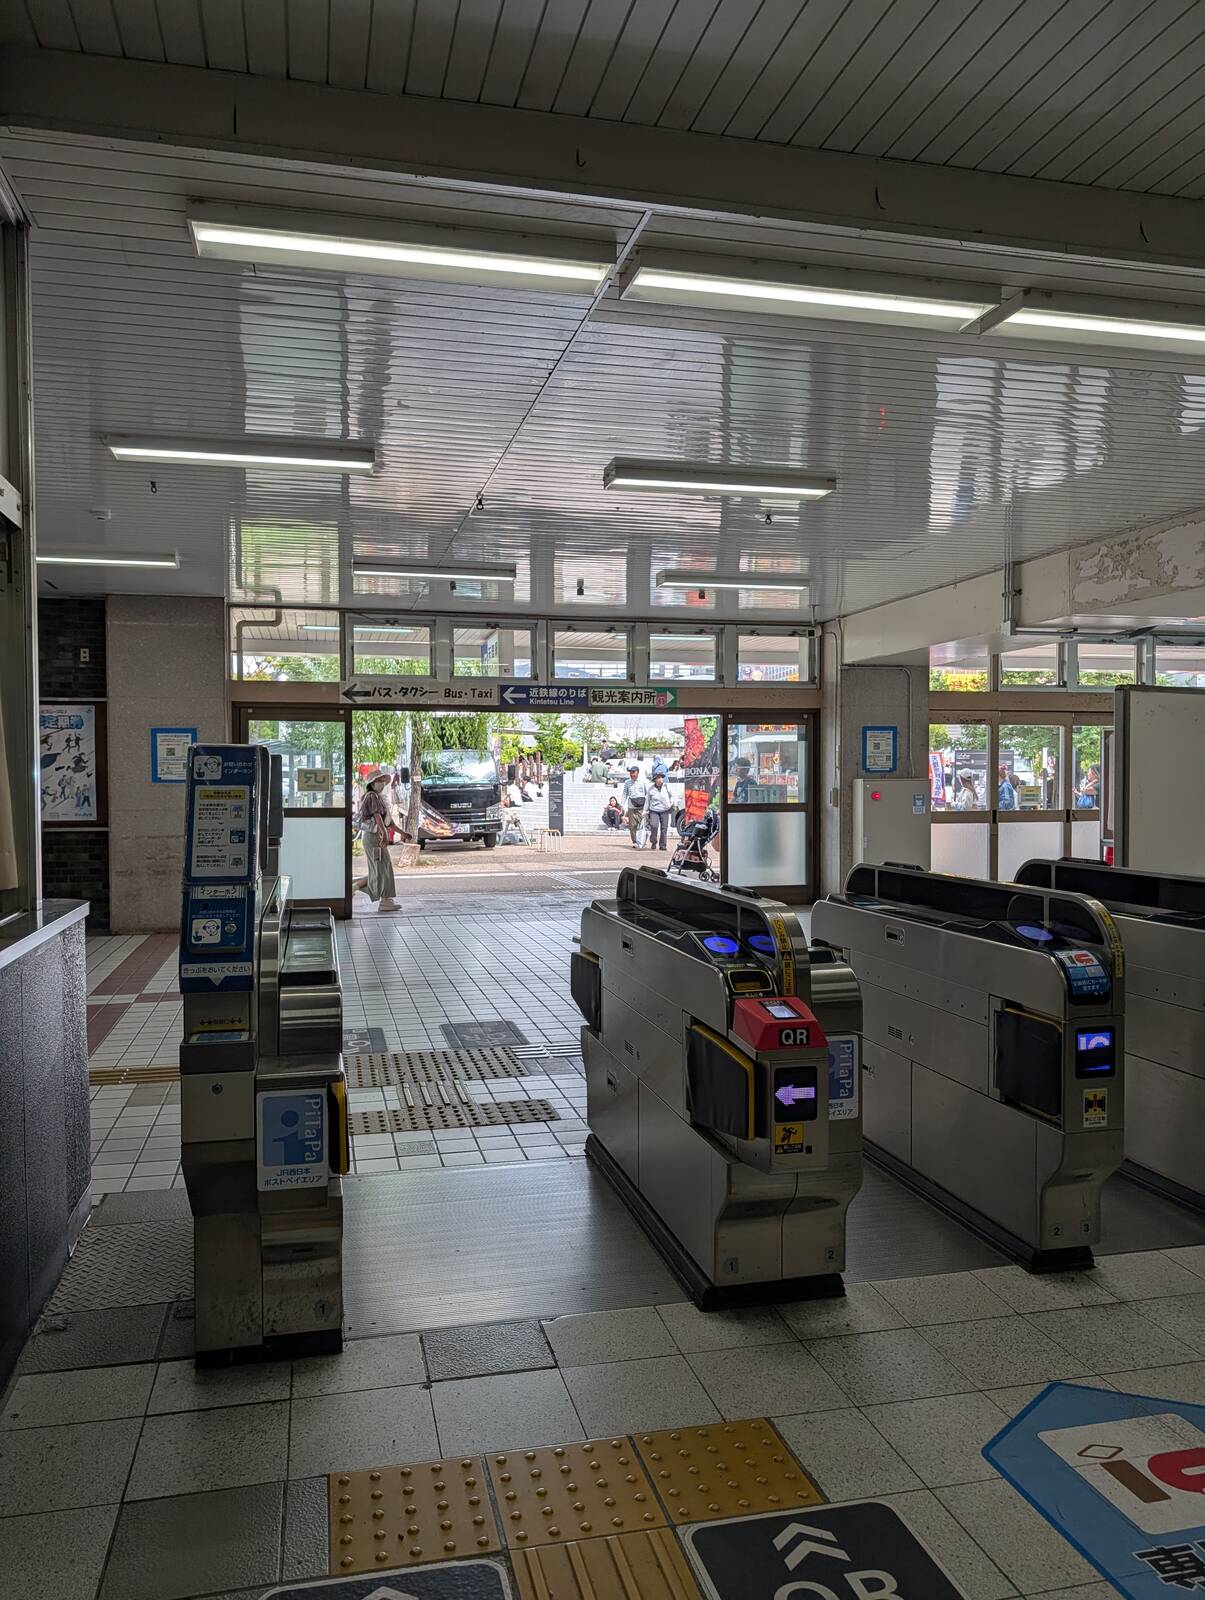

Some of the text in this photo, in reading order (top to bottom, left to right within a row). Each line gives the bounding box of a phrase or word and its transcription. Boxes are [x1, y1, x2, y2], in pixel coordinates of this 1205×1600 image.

[371, 686, 439, 698] バス・タクシー
[529, 687, 587, 698] 近鉄線のりば
[591, 690, 657, 705] 観光案内所
[781, 1029, 808, 1046] QR
[839, 1043, 853, 1097] PiTaPa
[304, 1097, 322, 1161] PiTaPa
[276, 1168, 311, 1177] JR西日本
[264, 1175, 323, 1187] ポストペイエリア
[1053, 1226, 1061, 1236] 2
[1083, 1223, 1090, 1233] 3
[827, 1250, 835, 1260] 2
[728, 1262, 734, 1272] 1
[319, 1303, 325, 1315] 1
